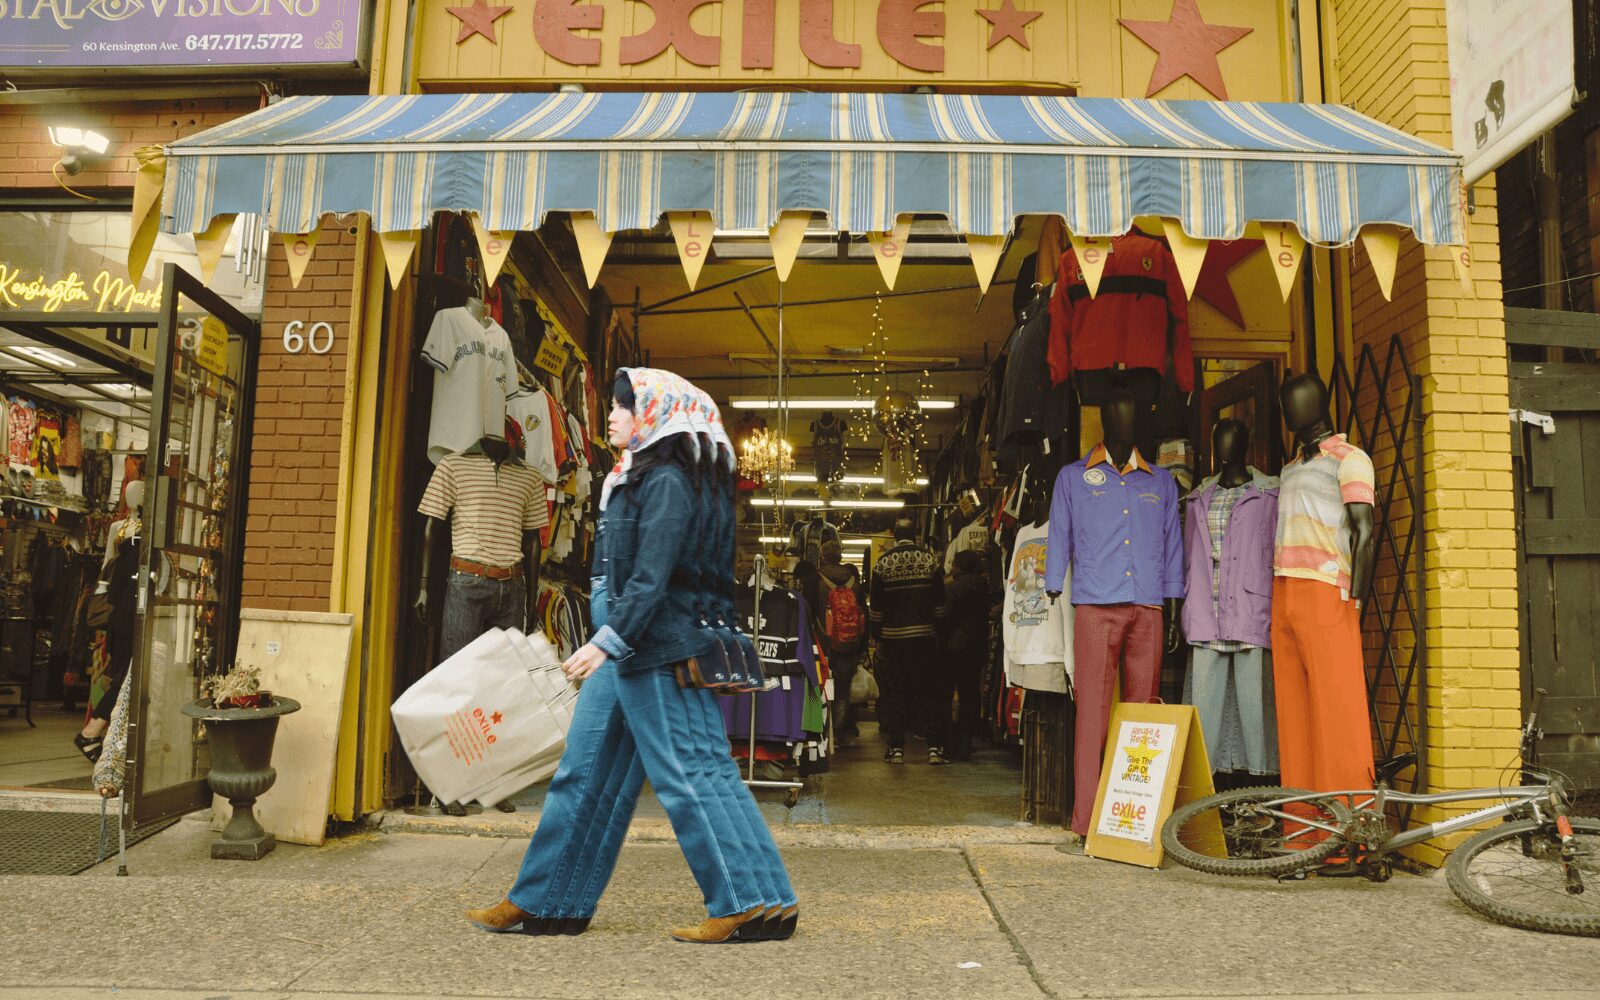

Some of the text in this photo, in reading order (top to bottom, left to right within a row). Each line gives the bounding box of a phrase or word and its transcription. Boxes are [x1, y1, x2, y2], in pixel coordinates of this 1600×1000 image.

[151, 0, 320, 17] VISIONS
[83, 33, 303, 52] 60 Kensington Ave. 647.717.5772
[0, 264, 90, 313] Kensington
[283, 320, 335, 354] 60
[757, 640, 779, 658] EAFS
[1127, 755, 1153, 766] Give The
